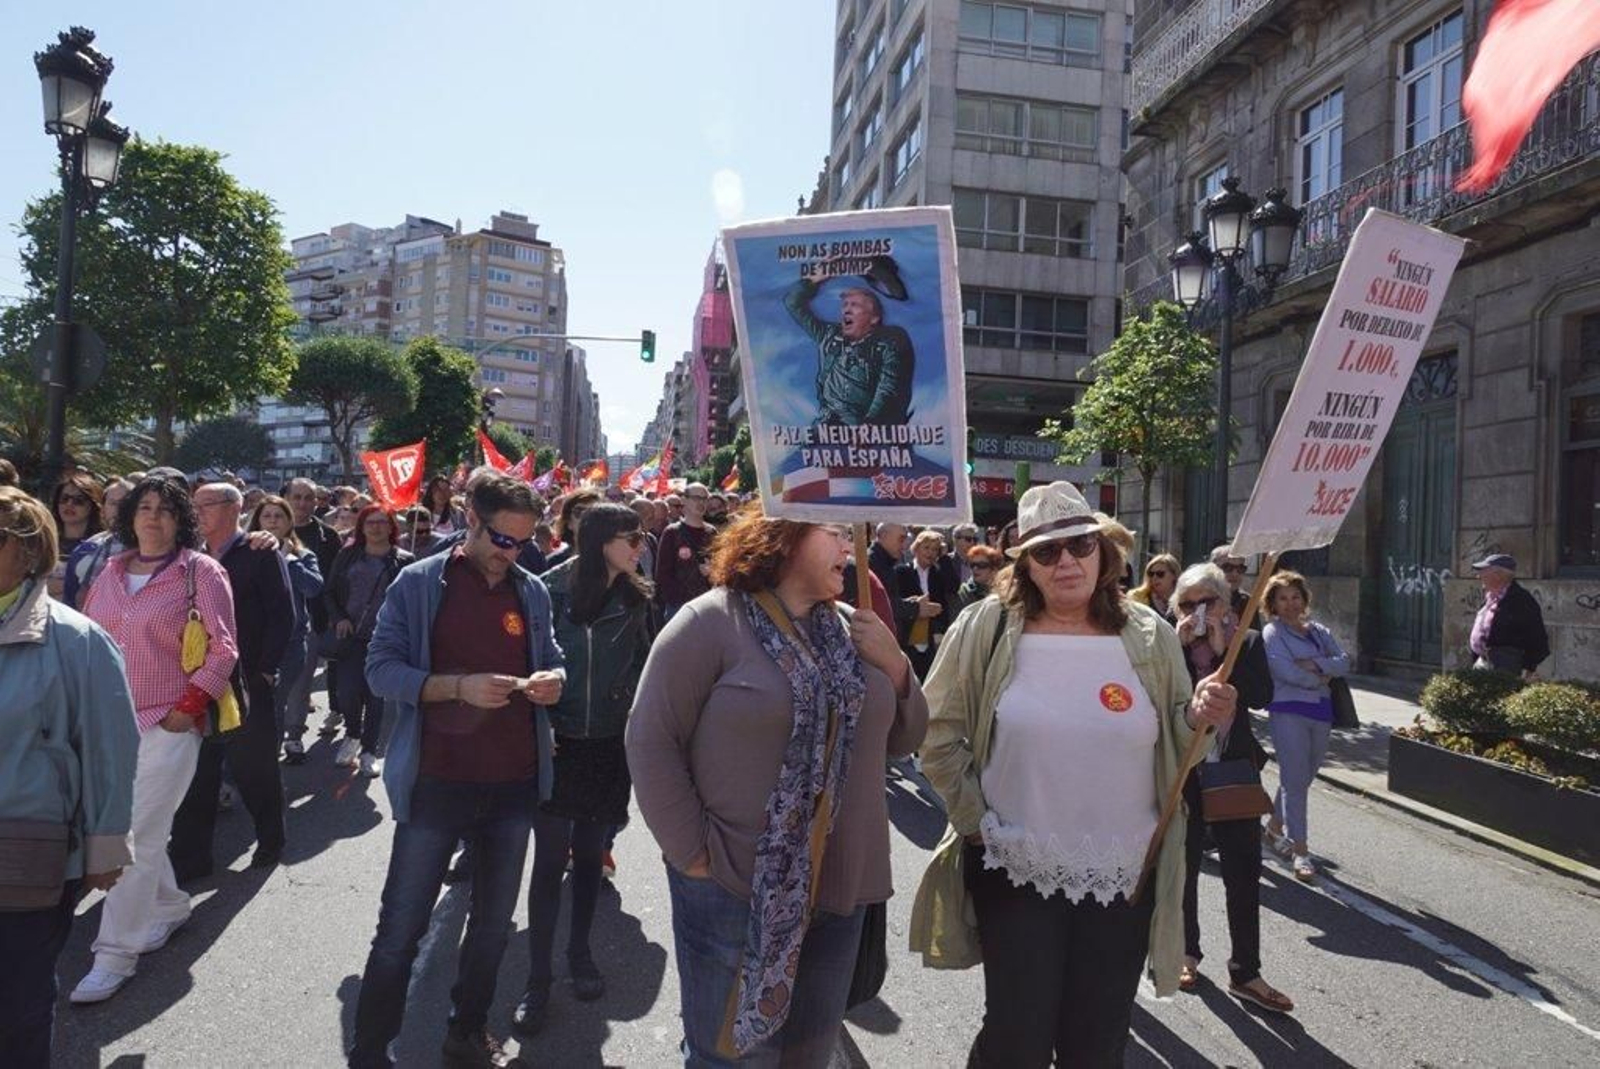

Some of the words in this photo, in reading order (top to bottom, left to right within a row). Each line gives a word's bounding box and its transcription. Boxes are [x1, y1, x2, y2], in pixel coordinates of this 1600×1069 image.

[778, 244, 808, 262] NON
[810, 242, 829, 260] AS
[831, 238, 893, 257] BOMBAS
[800, 262, 818, 279] DE
[1365, 277, 1429, 314] SALARIO
[1339, 309, 1370, 331] POR
[1317, 389, 1384, 419] NINGÚN
[773, 425, 800, 446] PAZ
[804, 426, 814, 446] E
[817, 423, 945, 446] NEUTRALIDADE
[1305, 420, 1332, 439] POR
[1331, 422, 1361, 440] RIBA
[1360, 424, 1378, 440] DE
[803, 449, 844, 467] PARA
[847, 447, 913, 468] ESPAÑA
[895, 474, 949, 499] UCE
